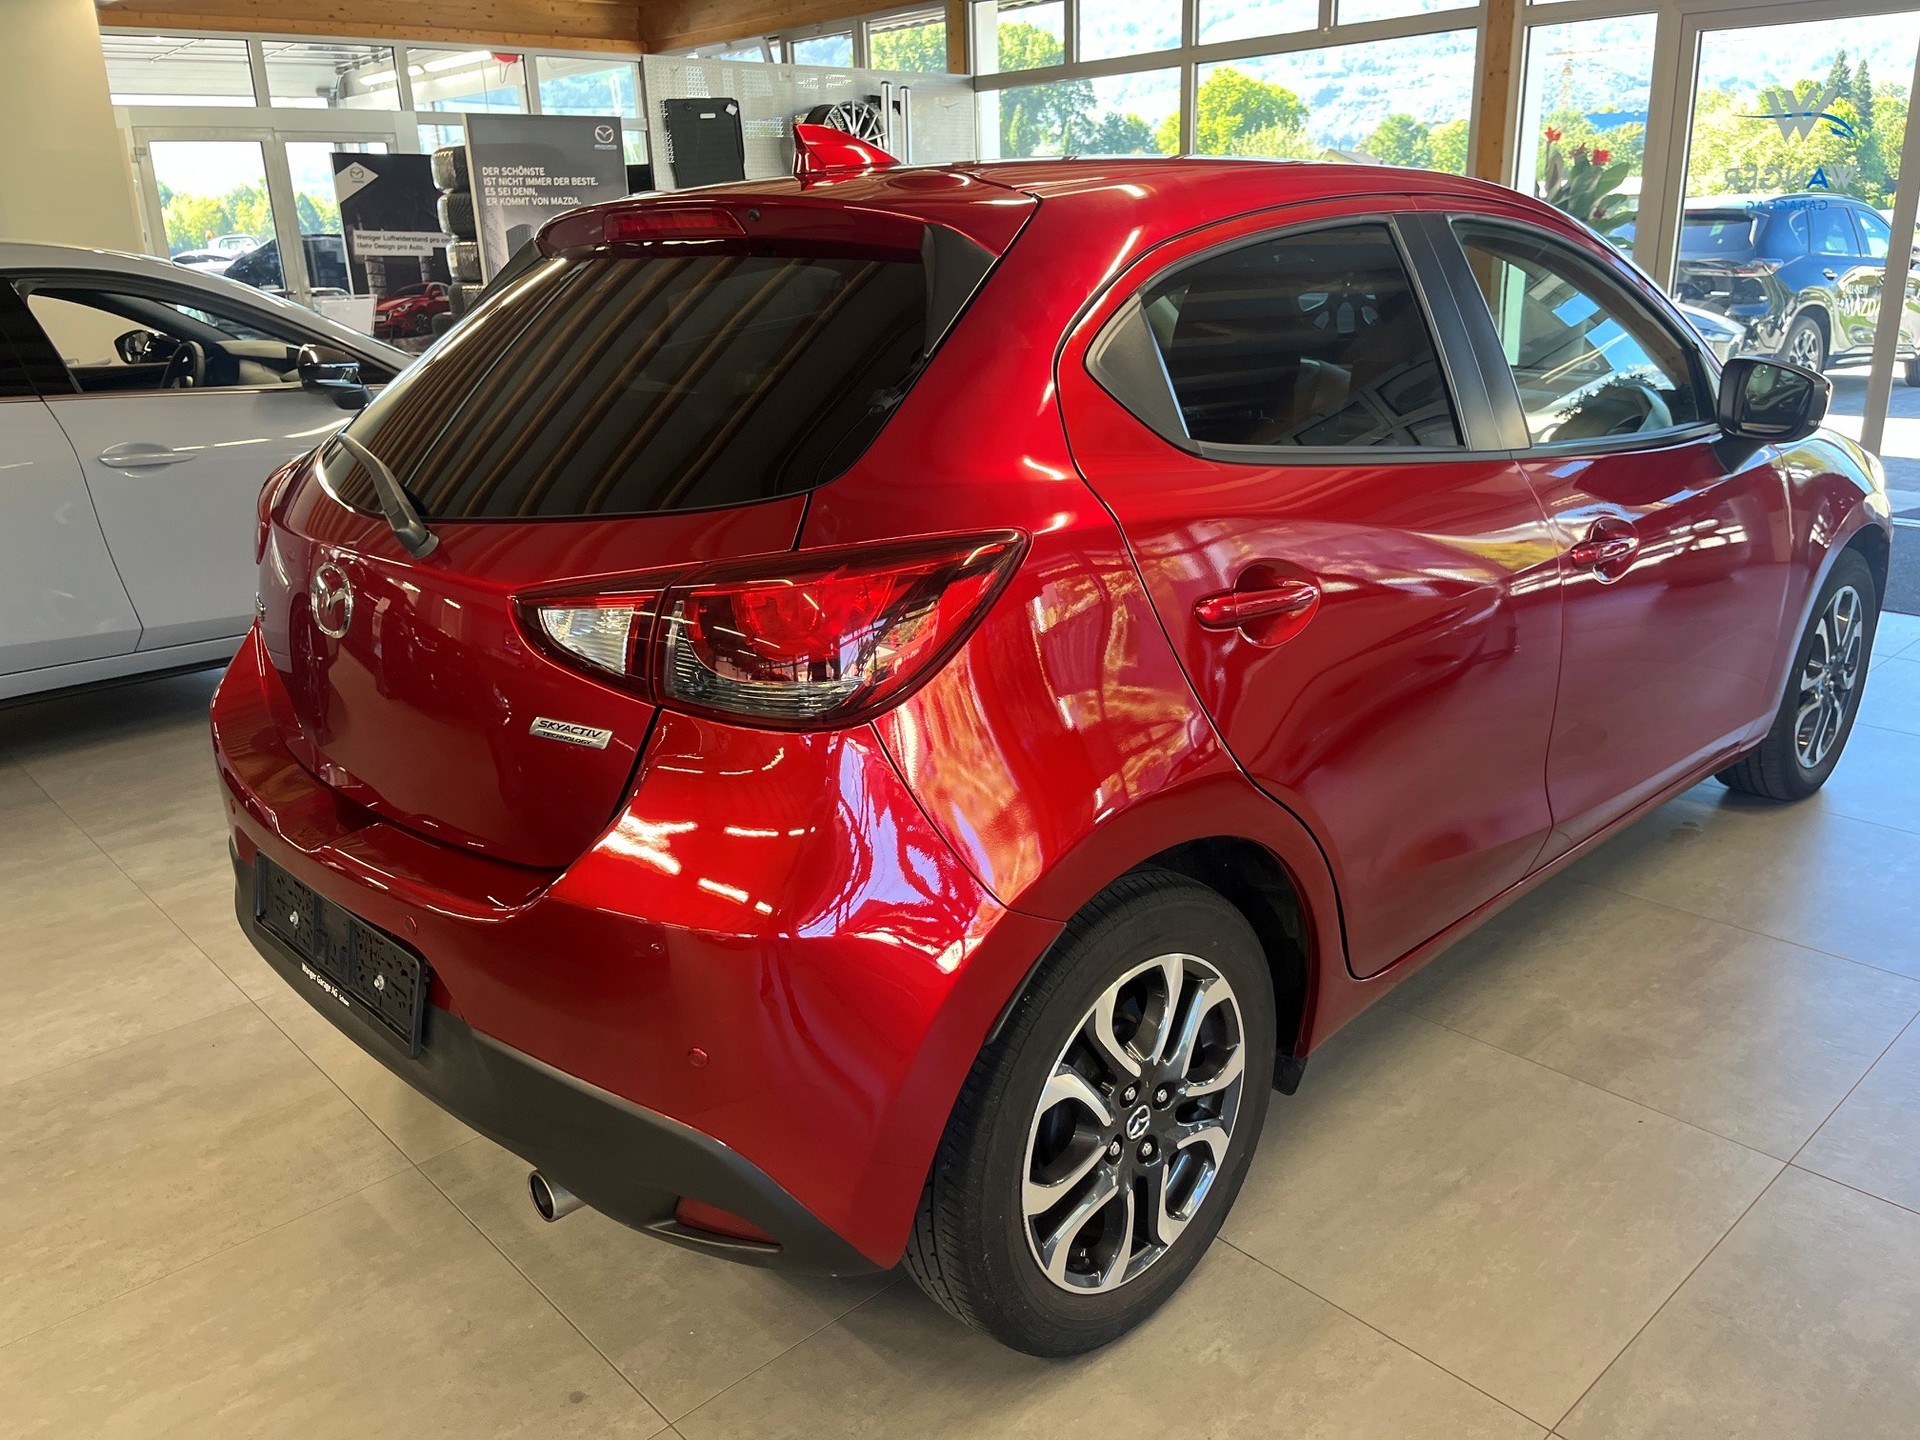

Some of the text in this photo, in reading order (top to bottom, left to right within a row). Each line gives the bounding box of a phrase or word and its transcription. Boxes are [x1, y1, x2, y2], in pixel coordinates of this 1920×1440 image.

[482, 165, 545, 176] DER SCHÖNSTE
[483, 177, 599, 186] IST NICHT IMMER DER BESTE.
[484, 187, 538, 197] ES SEI DENN,
[486, 197, 582, 206] ER KOMMT VON MAZDA.
[356, 233, 381, 242] Weniger
[374, 242, 396, 251] Design
[538, 720, 602, 738] SKYACTIV
[542, 731, 592, 745] TECHNOLOGY
[316, 975, 331, 992] Garage
[331, 986, 338, 998] AG
